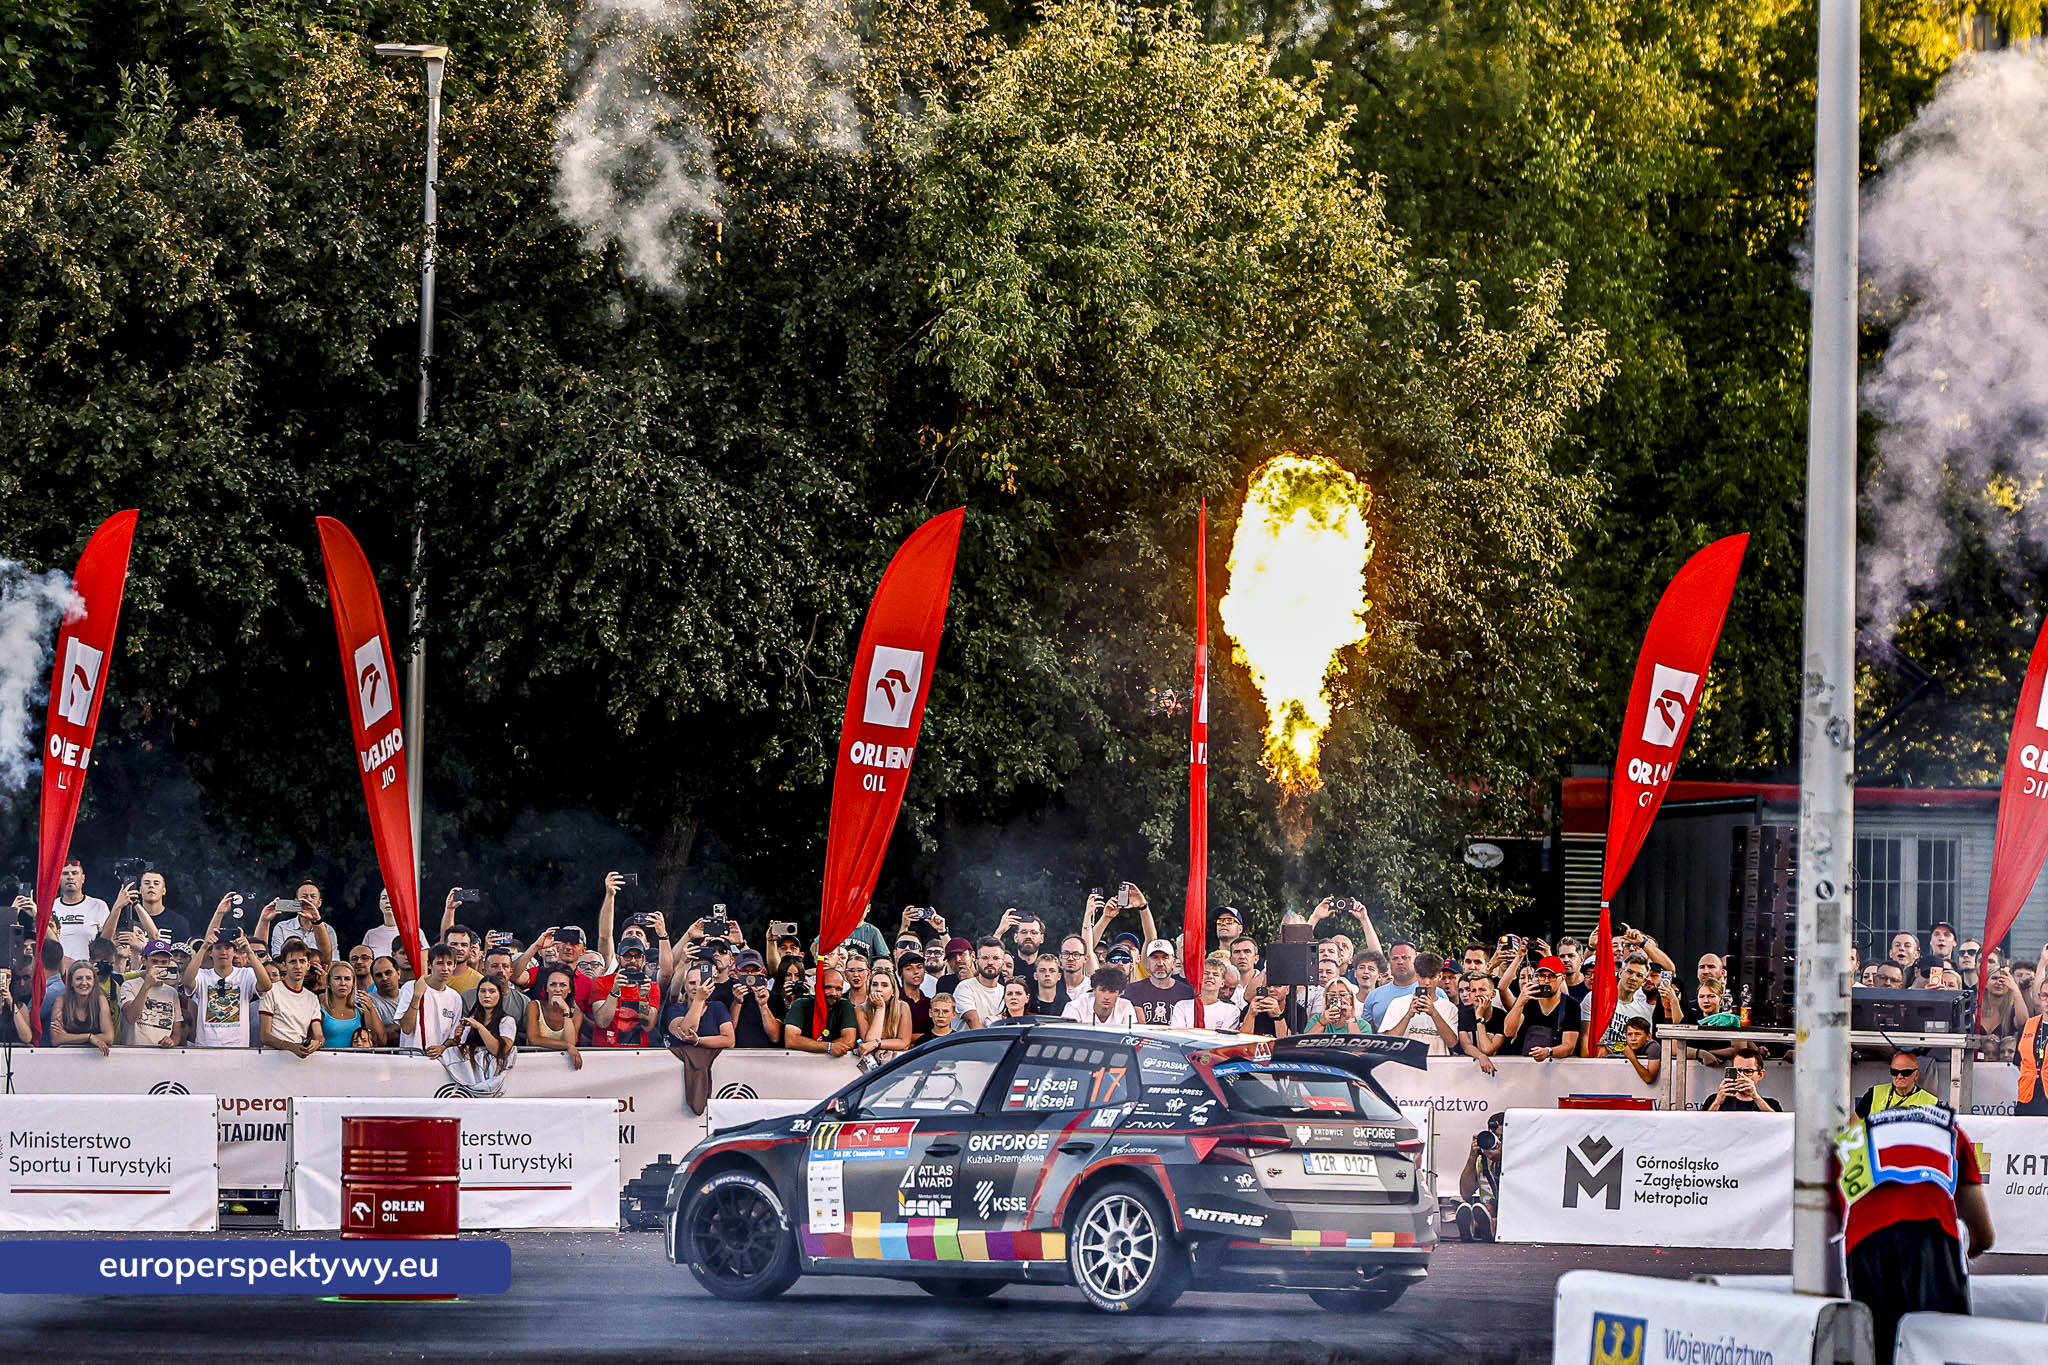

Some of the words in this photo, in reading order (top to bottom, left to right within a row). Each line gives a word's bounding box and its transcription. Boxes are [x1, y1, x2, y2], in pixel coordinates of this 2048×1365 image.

[850, 741, 914, 769] ORLEN
[863, 773, 887, 792] OIL
[1296, 1034, 1411, 1052] szeja.com.pl
[1156, 1060, 1190, 1071] STASIAK
[1090, 1066, 1128, 1103] 17
[1160, 1087, 1204, 1096] MEGA-PRESS
[217, 1098, 287, 1116] upera
[1026, 1094, 1075, 1110] M.Szeja
[217, 1123, 287, 1142] TADION
[817, 1123, 841, 1150] 17
[874, 1126, 900, 1135] ORLEN
[1353, 1127, 1396, 1139] GKFORGE
[10, 1131, 132, 1149] Ministerstwo
[968, 1133, 1050, 1152] GKFORGE
[9, 1155, 71, 1176] Sportu
[77, 1155, 82, 1173] i
[87, 1156, 172, 1177] Turystyki
[478, 1153, 483, 1170] i
[488, 1152, 573, 1174] Turystyki
[967, 1154, 993, 1164] Kuźnia
[994, 1153, 1045, 1165] Przemysłowa
[1315, 1154, 1337, 1172] 12R
[1344, 1156, 1373, 1173] 0127
[1636, 1155, 1719, 1173] Górnośląsko
[918, 1165, 953, 1176] ATLAS
[918, 1176, 953, 1188] WARD
[2005, 1181, 2025, 1196] dla
[381, 1200, 425, 1212] ORLEN
[993, 1197, 1027, 1212] KSSE
[1634, 1190, 1708, 1208] Metropolia
[381, 1213, 399, 1223] OIL
[1663, 1327, 1774, 1365] Województwo
